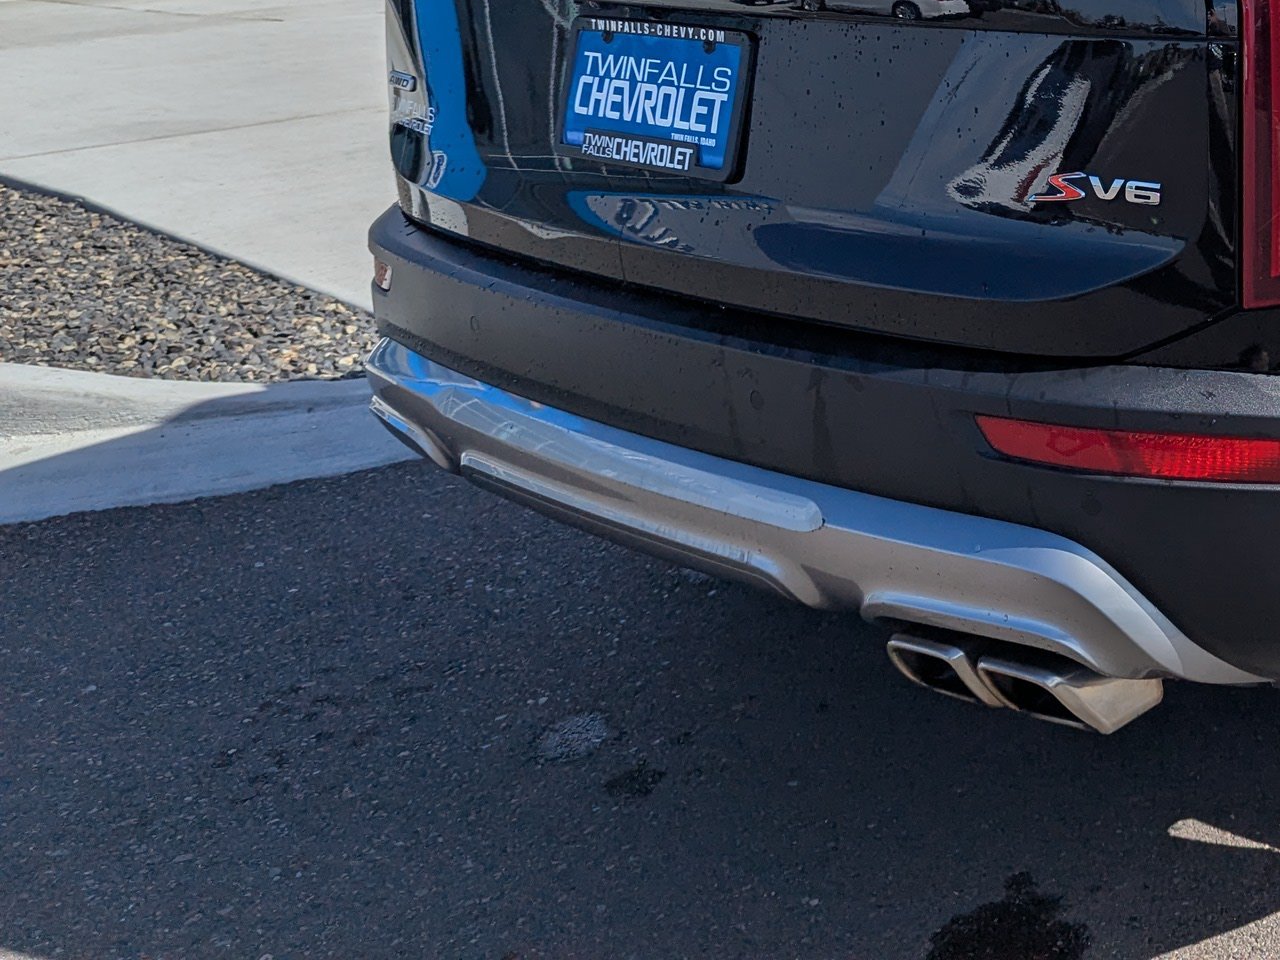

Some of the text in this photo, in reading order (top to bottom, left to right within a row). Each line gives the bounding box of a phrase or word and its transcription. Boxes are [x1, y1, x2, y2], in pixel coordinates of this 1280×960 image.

[591, 18, 725, 42] TWINFALLS-CHEVY.COM
[584, 51, 732, 92] TWINFALLS
[390, 75, 409, 88] AWD
[574, 75, 728, 134] CHEVROLET
[584, 133, 614, 148] TWIN
[671, 132, 685, 143] TWIN
[700, 136, 716, 147] IDAHO
[582, 144, 613, 158] FALLS
[612, 137, 694, 171] CHEVROLET
